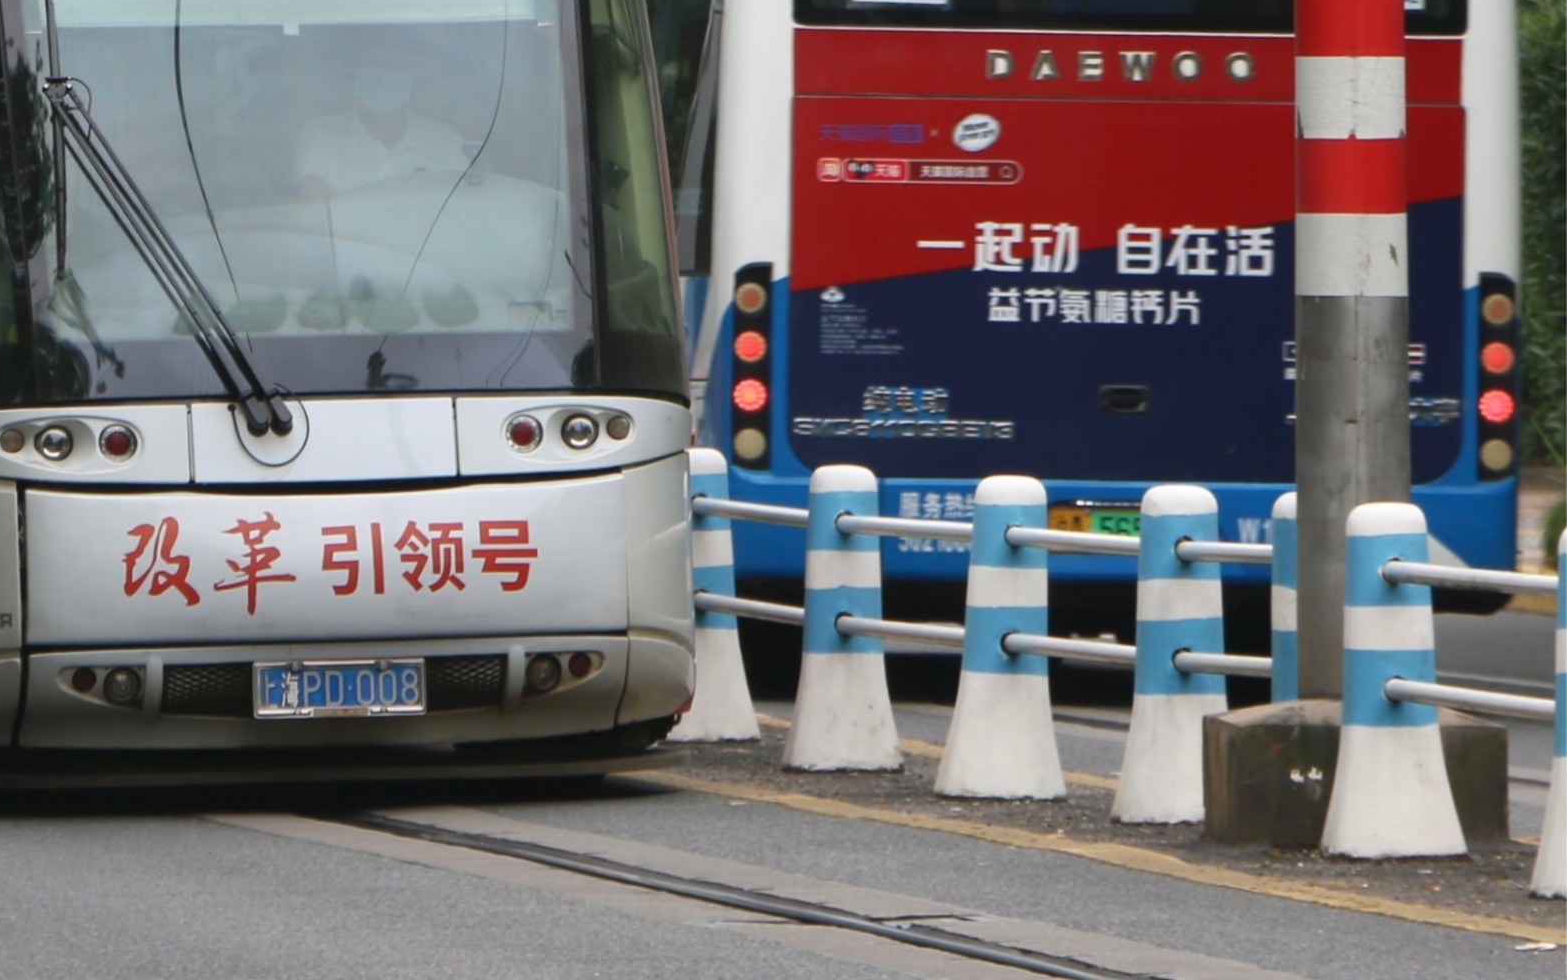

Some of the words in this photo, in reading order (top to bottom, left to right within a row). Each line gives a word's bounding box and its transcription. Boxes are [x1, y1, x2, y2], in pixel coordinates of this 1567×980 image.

[985, 49, 1255, 82] DAEWOO
[917, 221, 1079, 273] 一起动
[1117, 223, 1275, 277] 自在活
[988, 286, 1202, 325] 益节氨糖钙片
